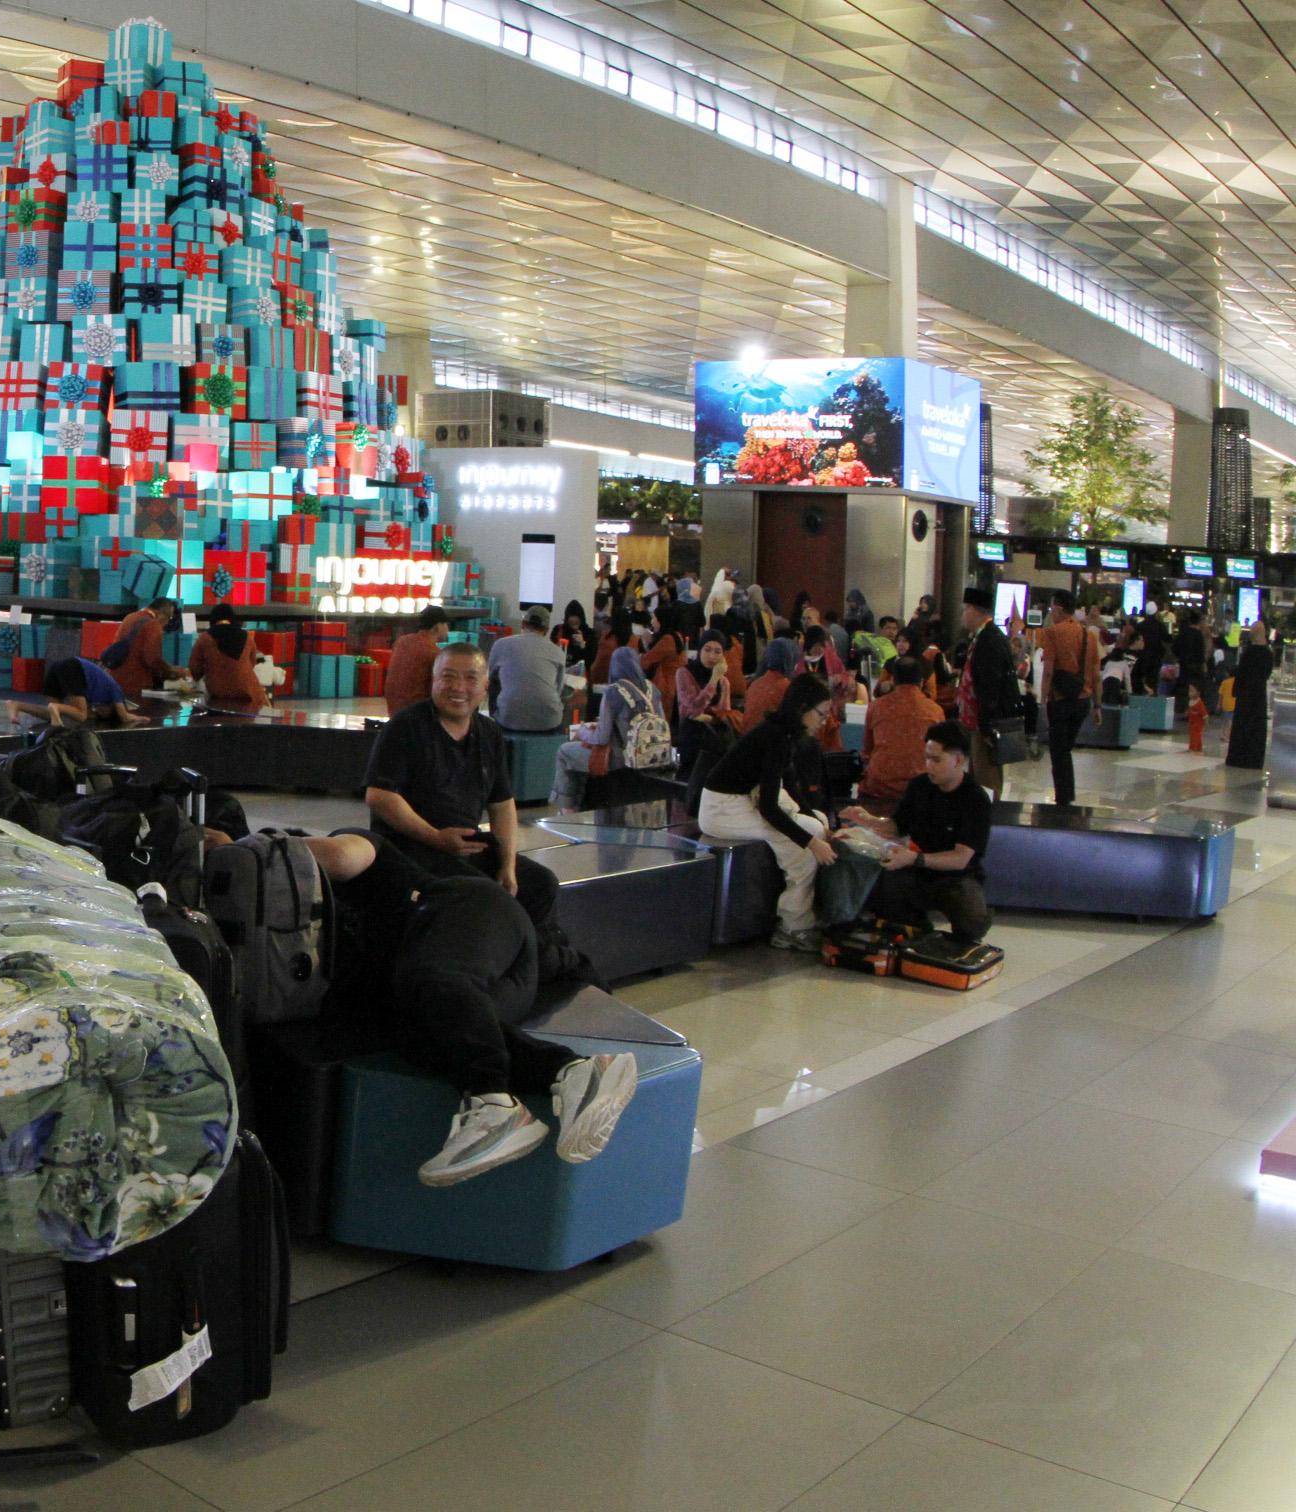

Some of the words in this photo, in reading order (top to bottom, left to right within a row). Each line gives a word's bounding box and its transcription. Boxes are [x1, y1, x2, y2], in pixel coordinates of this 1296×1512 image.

[741, 411, 808, 427] traveloka
[819, 414, 854, 429] FIRST,
[922, 399, 966, 428] traveloka
[458, 464, 561, 493] injourney
[315, 556, 449, 598] injourney
